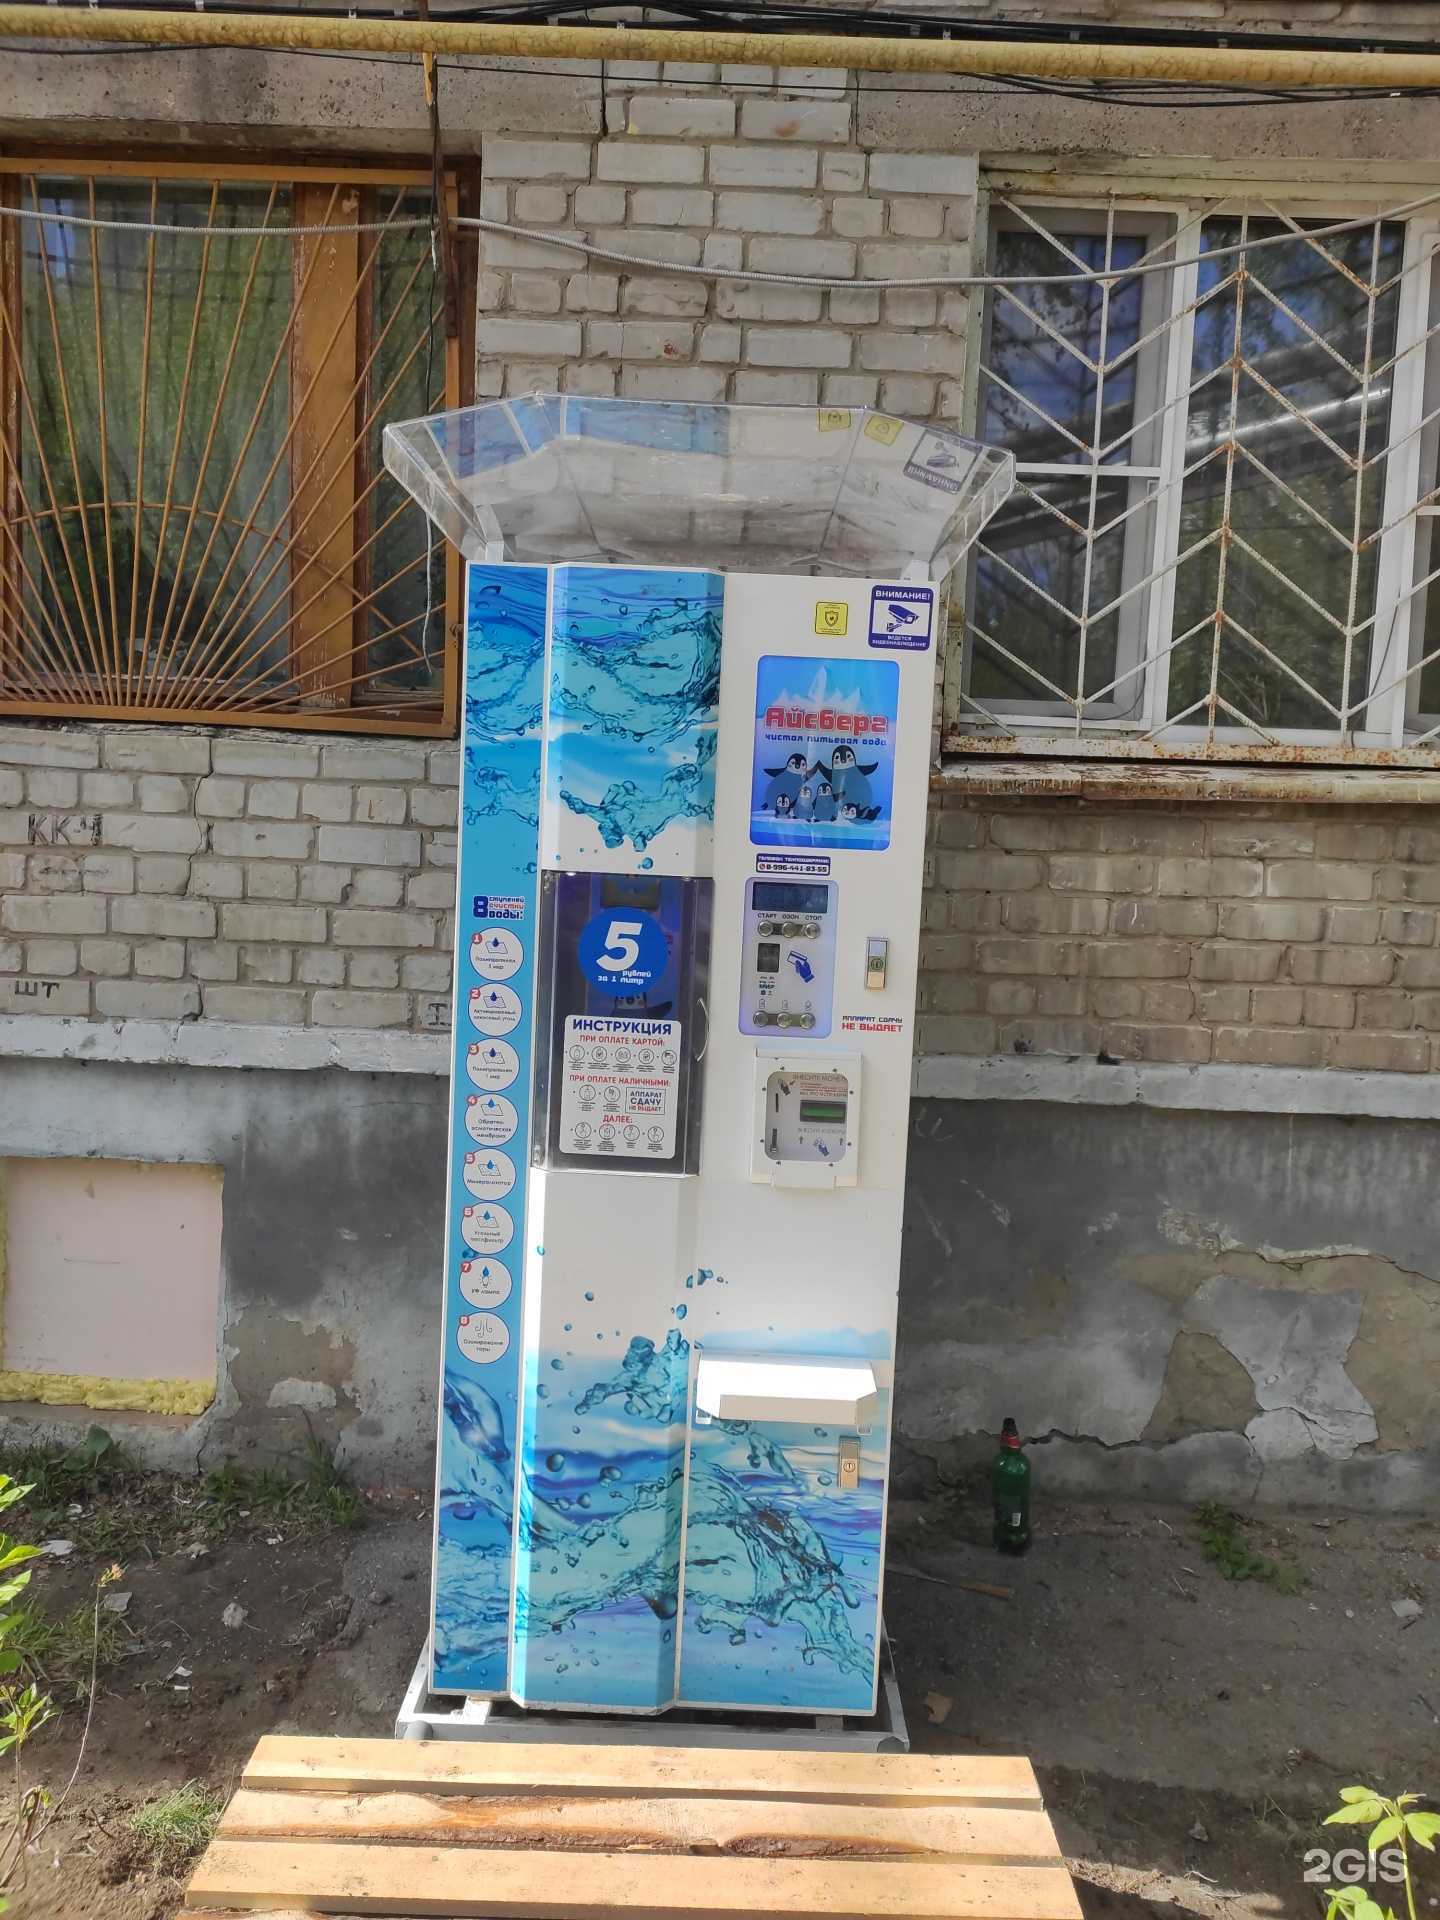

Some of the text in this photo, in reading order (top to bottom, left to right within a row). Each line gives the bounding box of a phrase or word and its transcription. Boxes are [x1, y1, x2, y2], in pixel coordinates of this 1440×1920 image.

[875, 590, 930, 601] ВНИМАНИЕ!
[765, 705, 888, 736] Айсберг
[765, 733, 887, 746] чистая питьевая вода
[473, 896, 488, 917] 8
[489, 909, 524, 919] воды:
[473, 934, 480, 942] 1
[596, 921, 643, 972] 5
[622, 970, 651, 978] рублей
[620, 977, 644, 985] литр
[471, 989, 479, 997] 2
[572, 1018, 672, 1035] ИНСТРУКЦИЯ
[841, 1022, 903, 1032] НЕ ВЫДАЕТ
[580, 1034, 665, 1046] ПРИ ОПЛАТЕ КАРТОЙ:
[470, 1045, 478, 1053] 3
[569, 1074, 671, 1086] ПРИ ОПЛАТЕ НАЛИЧНЫМИ:
[602, 1114, 633, 1123] ДАЛЕЕ:
[466, 1154, 473, 1163] 5
[464, 1207, 472, 1216] 6
[462, 1262, 470, 1271] 7
[460, 1316, 468, 1325] 8
